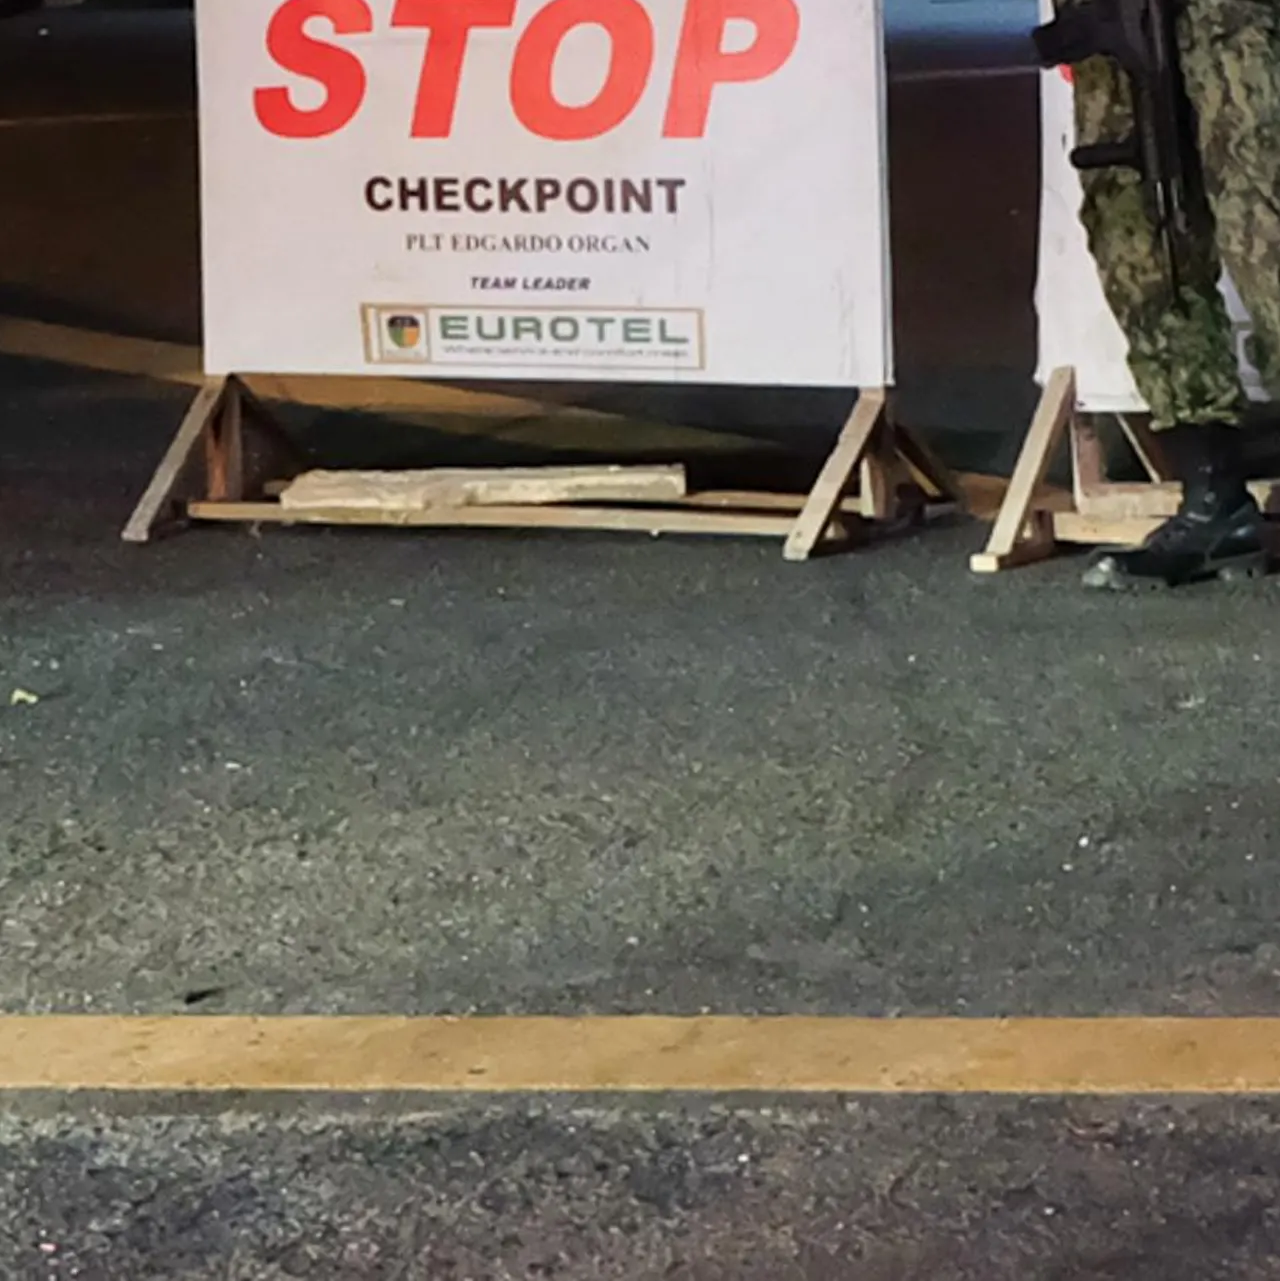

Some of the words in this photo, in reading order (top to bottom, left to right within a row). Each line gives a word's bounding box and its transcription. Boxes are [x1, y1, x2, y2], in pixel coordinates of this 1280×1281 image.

[364, 176, 686, 214] CHECKPOINT
[406, 234, 445, 251] PLT
[451, 234, 563, 252] EDGARDO
[567, 234, 651, 252] ORGAN
[470, 276, 516, 290] TEAM
[521, 276, 591, 291] LEADER
[439, 314, 690, 344] EUROTEL
